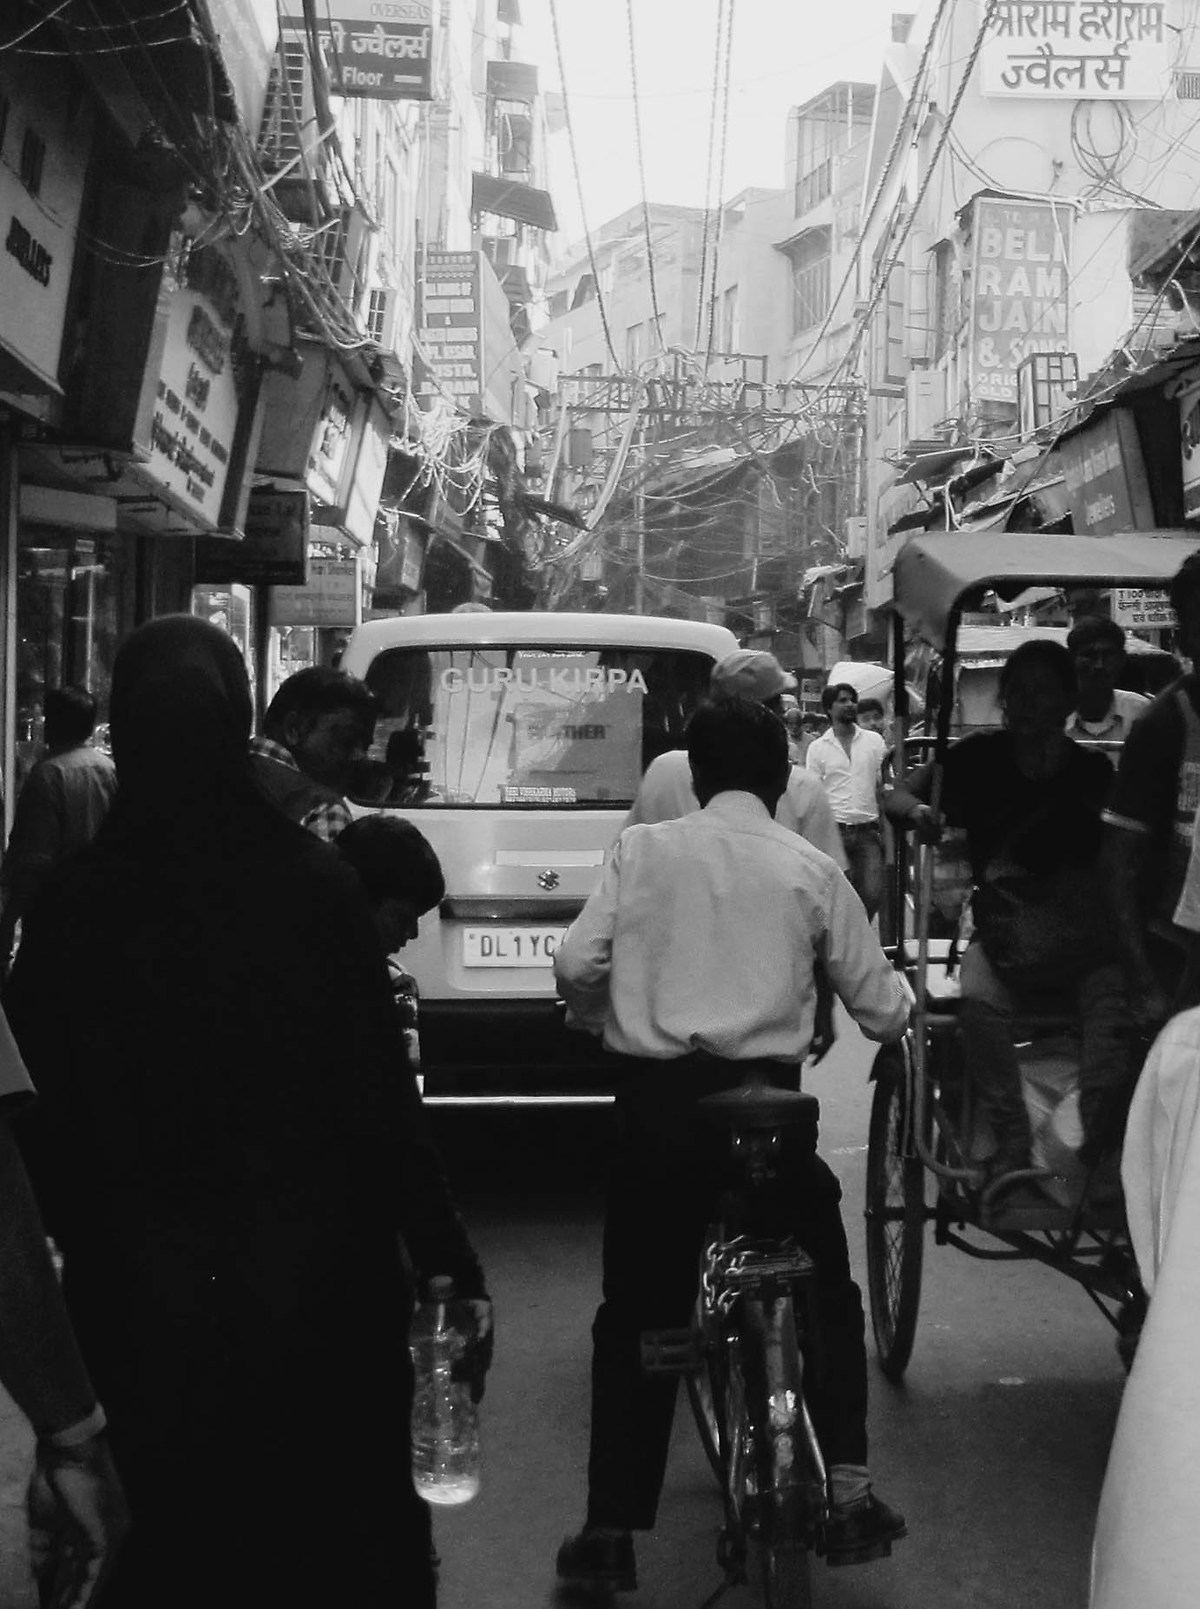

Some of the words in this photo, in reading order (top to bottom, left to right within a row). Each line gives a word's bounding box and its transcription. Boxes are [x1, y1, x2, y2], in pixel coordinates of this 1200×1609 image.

[342, 66, 383, 86] Floor
[978, 264, 1063, 297] RAM
[978, 300, 1068, 334] JAIN
[440, 666, 539, 694] GURU
[549, 666, 650, 696] KIRPA
